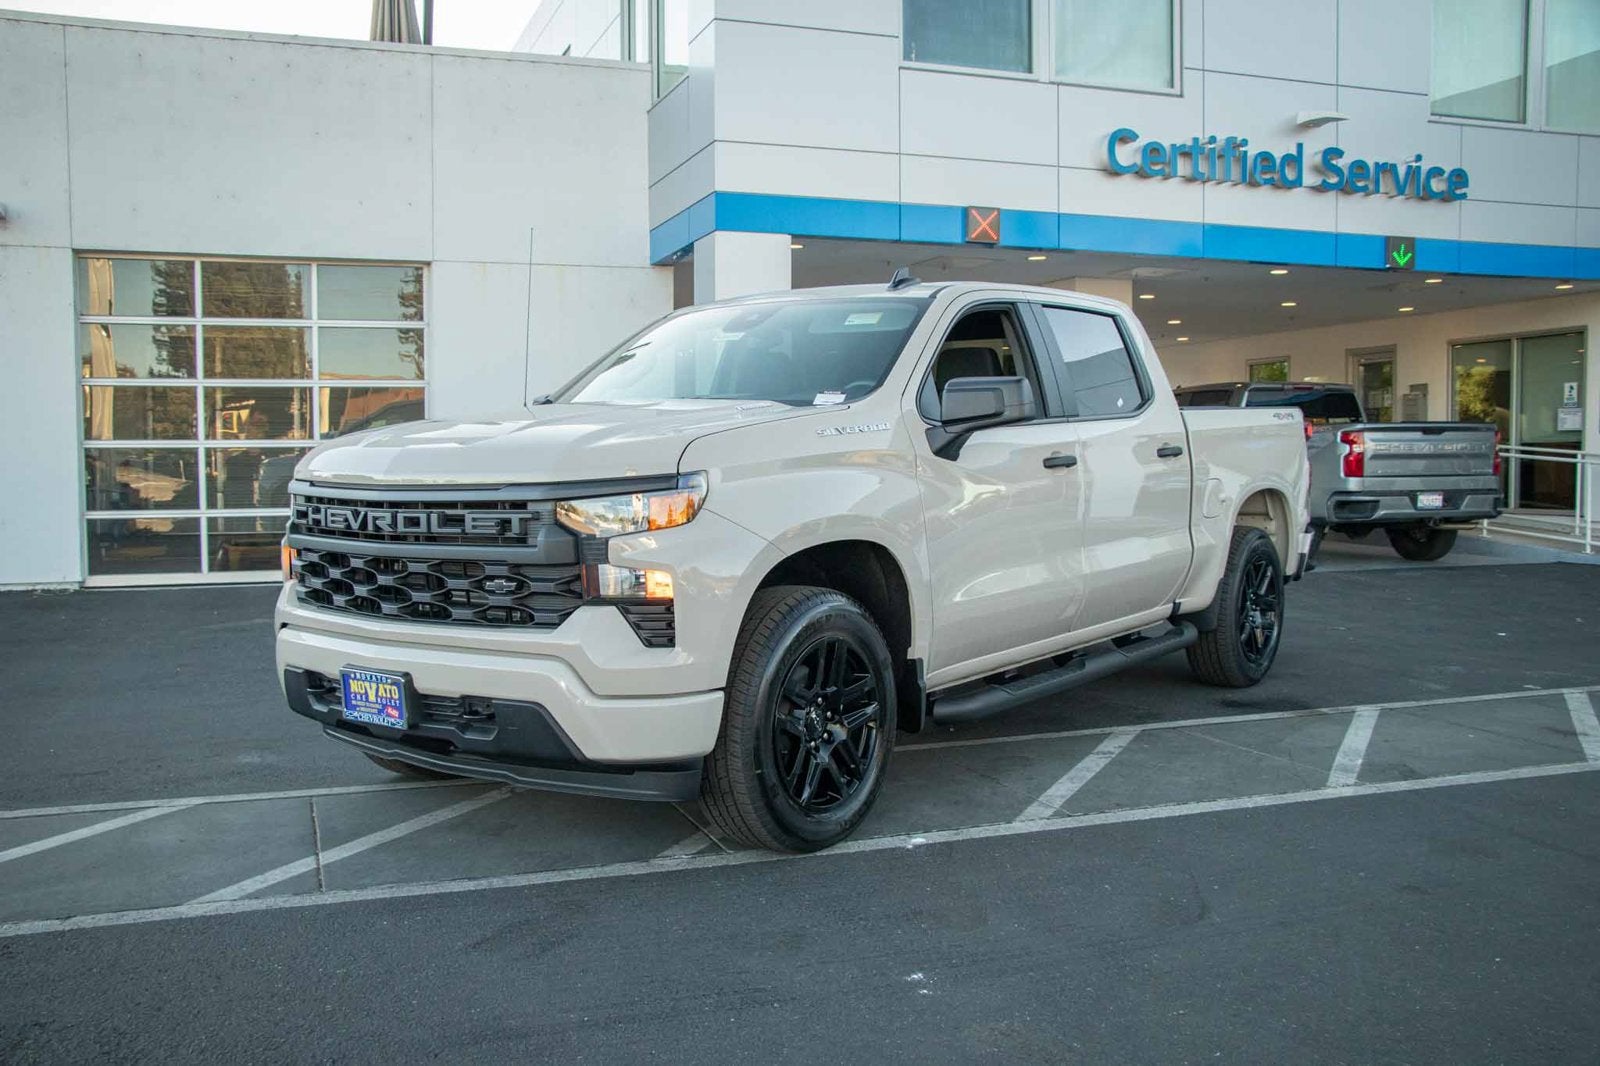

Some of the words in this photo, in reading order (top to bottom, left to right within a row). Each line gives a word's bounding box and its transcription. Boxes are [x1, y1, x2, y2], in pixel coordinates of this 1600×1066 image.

[1107, 127, 1303, 189] Certified
[1321, 146, 1470, 200] Service
[292, 505, 536, 536] CHEVROLET
[349, 679, 399, 702] NOVATO
